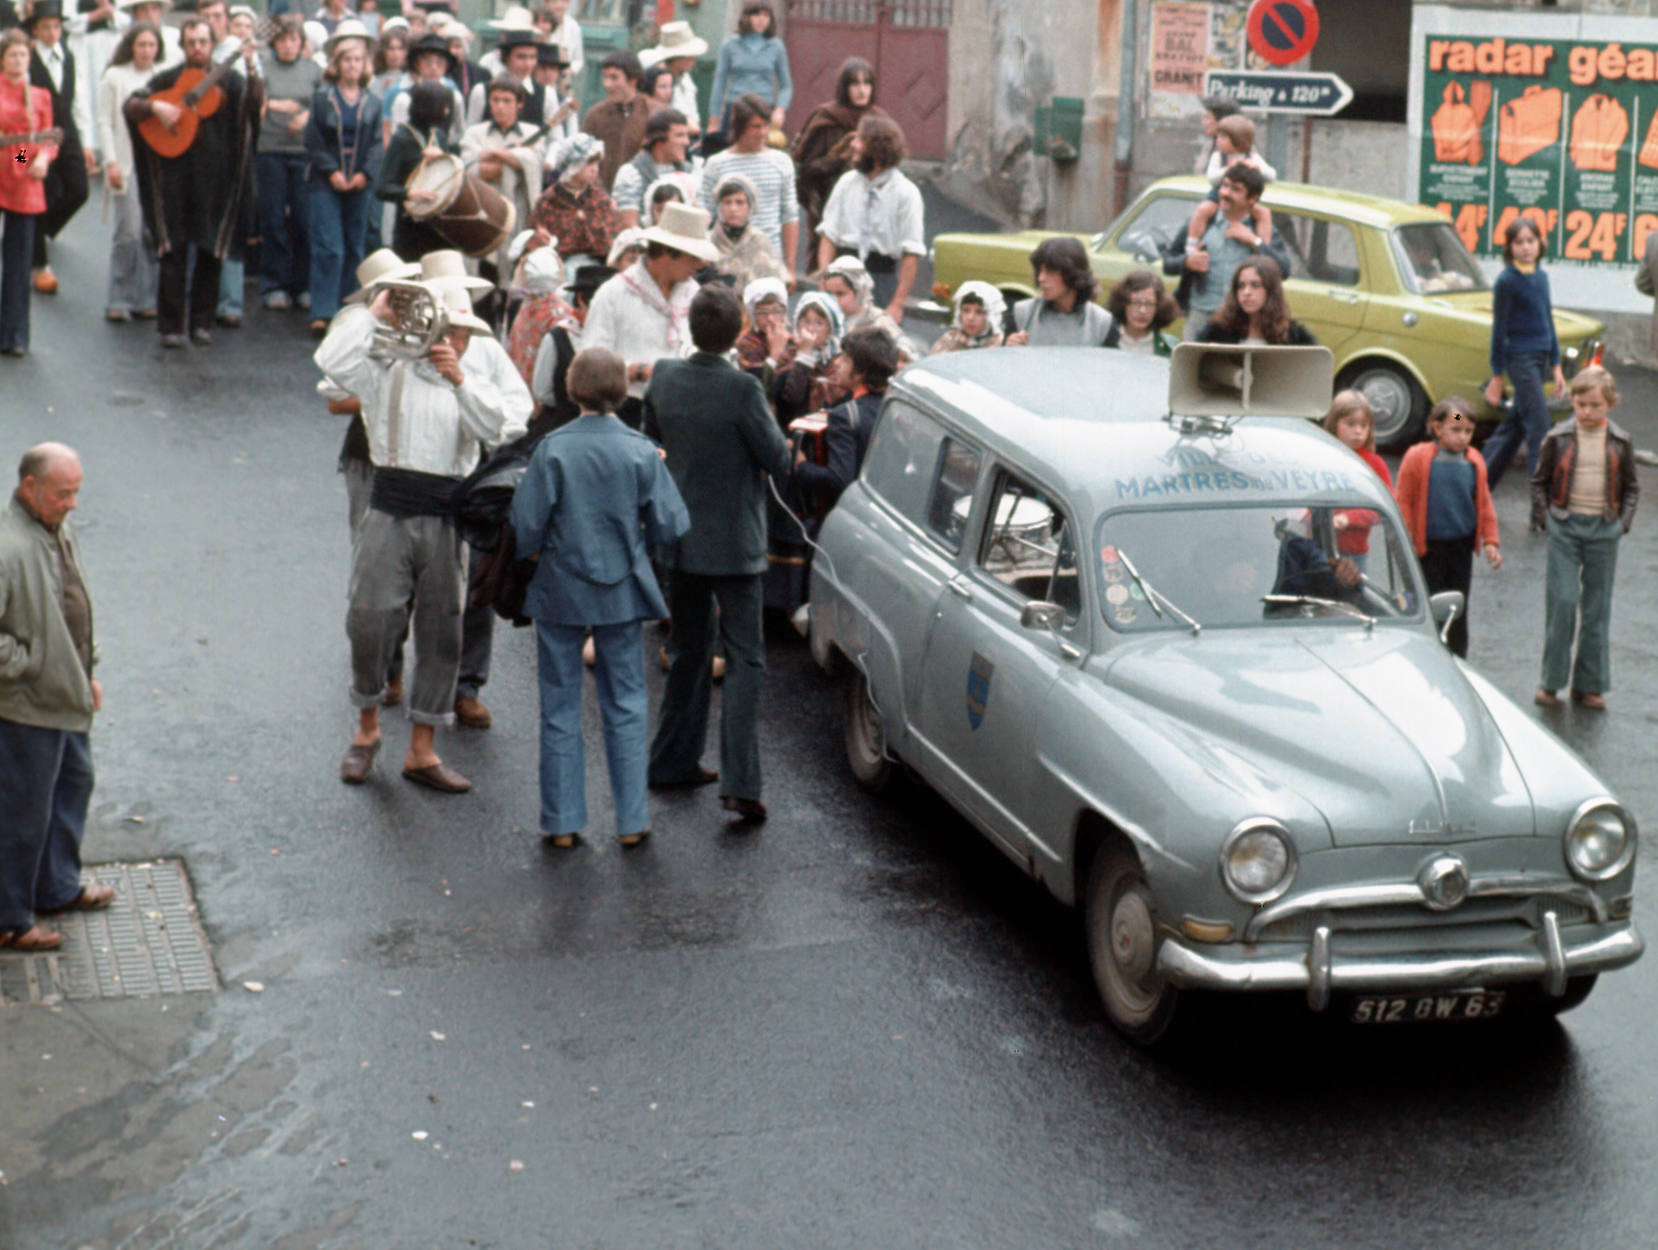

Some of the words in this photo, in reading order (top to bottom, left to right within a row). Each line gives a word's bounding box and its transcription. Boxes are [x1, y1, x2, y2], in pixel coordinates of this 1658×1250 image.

[1429, 37, 1554, 75] radar
[1568, 43, 1658, 86] géa
[1205, 79, 1274, 106] Parking
[1565, 210, 1627, 261] 24F
[1115, 471, 1249, 498] MARTRES
[1271, 469, 1357, 491] VEYRE
[1354, 1000, 1407, 1022] 512
